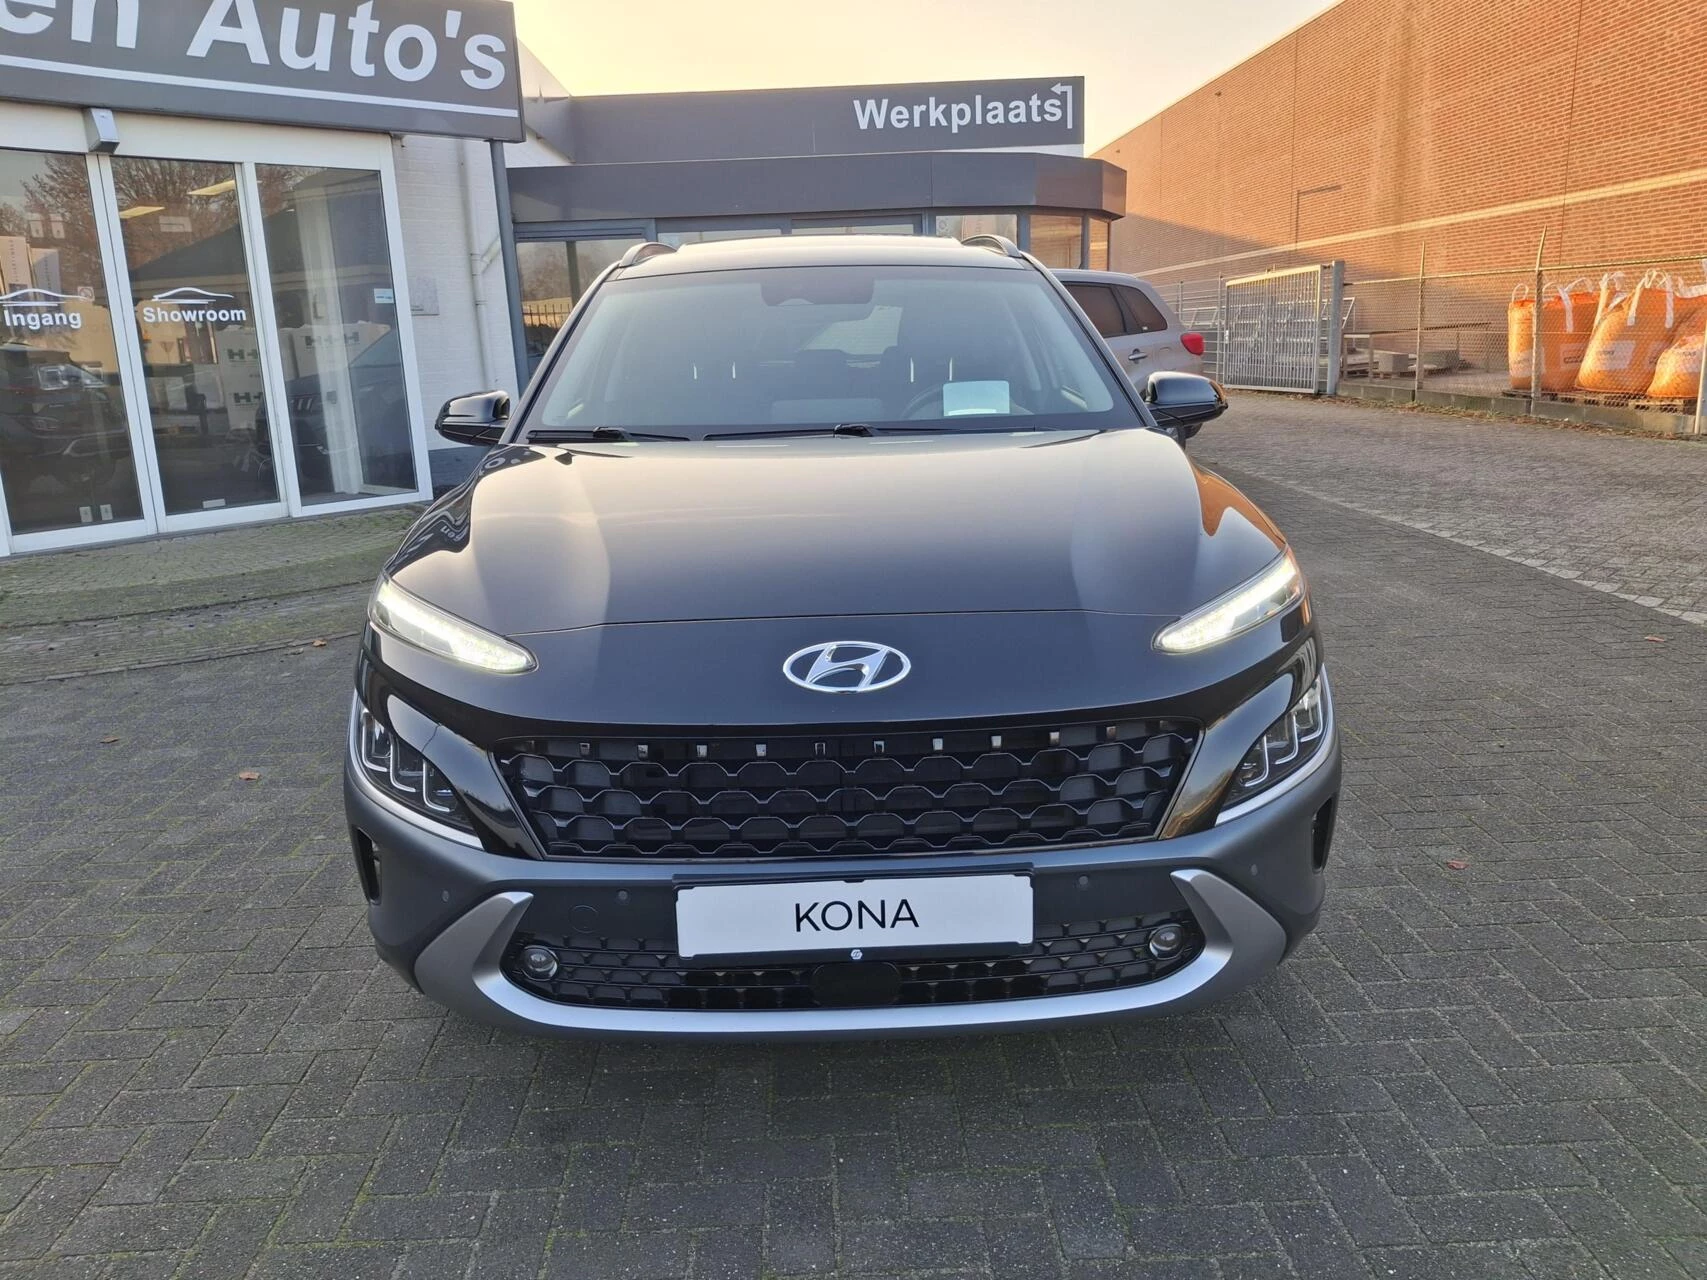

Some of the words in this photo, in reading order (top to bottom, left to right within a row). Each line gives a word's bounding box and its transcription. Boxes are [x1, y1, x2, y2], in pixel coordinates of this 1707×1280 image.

[186, 0, 506, 90] Auto's
[853, 93, 1062, 133] Werkplaats
[3, 309, 82, 330] Ingang
[143, 307, 247, 322] Showroom
[795, 899, 920, 932] KONA
